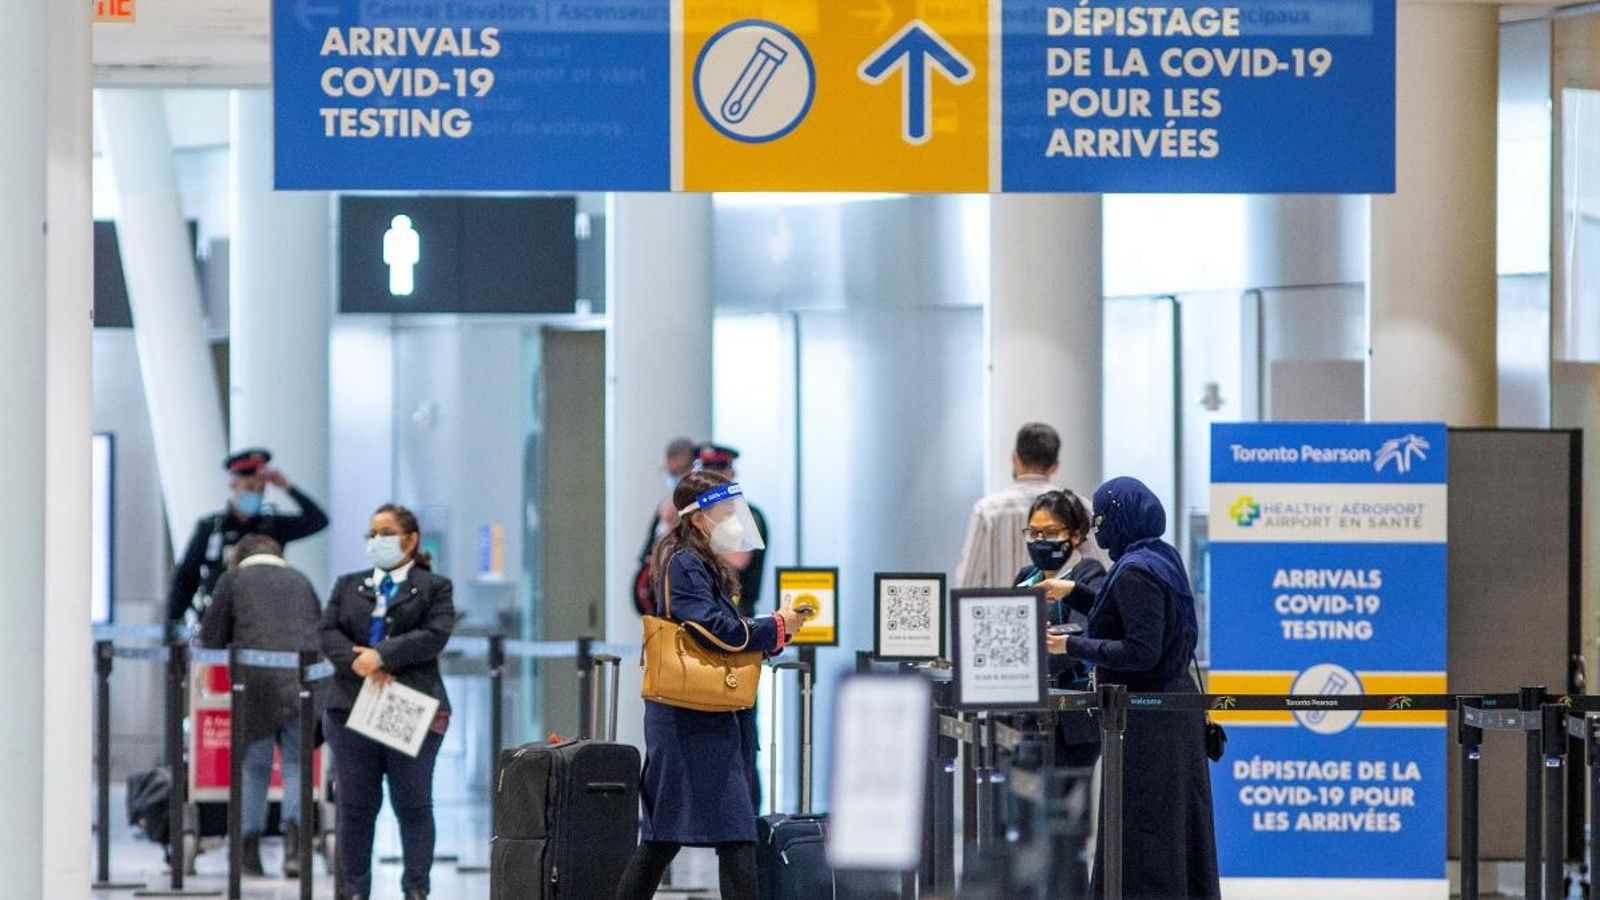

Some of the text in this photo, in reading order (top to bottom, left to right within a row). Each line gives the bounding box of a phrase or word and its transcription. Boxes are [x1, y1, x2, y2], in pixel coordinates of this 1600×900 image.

[1048, 0, 1239, 36] DÉPISTAGE
[321, 27, 500, 57] ARRIVALS
[1048, 48, 1090, 76] DE
[1104, 48, 1148, 76] LA
[1161, 48, 1331, 77] COVID-19
[321, 67, 494, 97] COVID-19
[1048, 88, 1151, 117] POUR
[1165, 88, 1221, 117] LES
[320, 108, 471, 138] TESTING
[1046, 120, 1219, 158] ARRIVÉES
[1230, 444, 1371, 462] Toronto Pearson
[1264, 503, 1331, 514] HEALTHY
[1264, 516, 1331, 528] AIRPORT
[1340, 516, 1361, 528] EN
[1272, 569, 1382, 589] ARRIVALS
[1274, 594, 1380, 614] COVID-19
[1281, 619, 1373, 640] TESTING
[1233, 755, 1421, 781] DÉPISTAGE DE LA
[1239, 786, 1414, 806] COVID-19 POUR
[1253, 807, 1401, 832] LES ARRIVÉES
